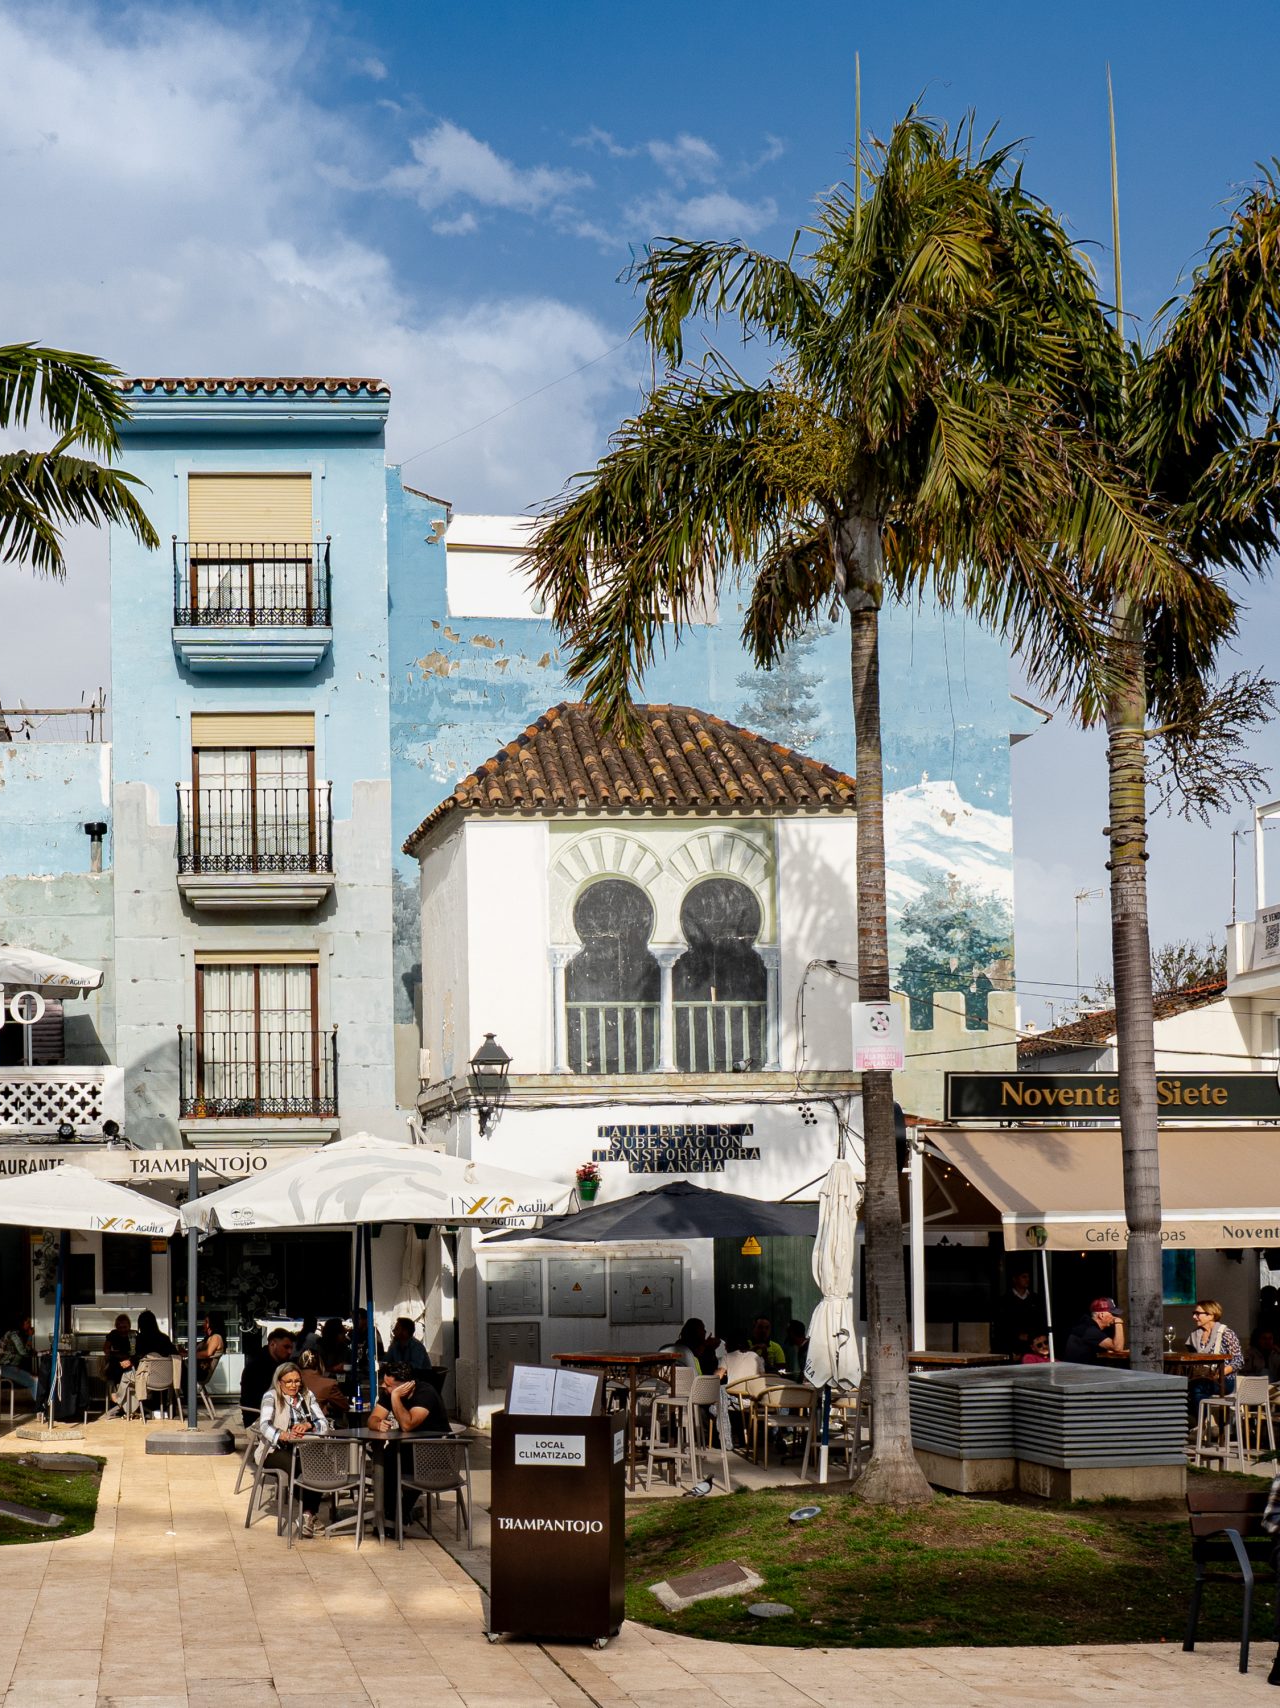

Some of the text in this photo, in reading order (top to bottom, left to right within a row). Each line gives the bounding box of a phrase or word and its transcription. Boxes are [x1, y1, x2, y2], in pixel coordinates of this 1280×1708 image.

[1001, 1080, 1228, 1106] Noventa Siete
[599, 1124, 753, 1137] TAILLEFER S A
[593, 1148, 761, 1161] TRANSFORMADORA
[630, 1161, 724, 1173] CALANCHA
[1086, 1228, 1120, 1242] Café
[1222, 1225, 1280, 1240] Novent
[535, 1441, 565, 1449] LOCAL
[518, 1451, 582, 1460] CLIMATIZADO
